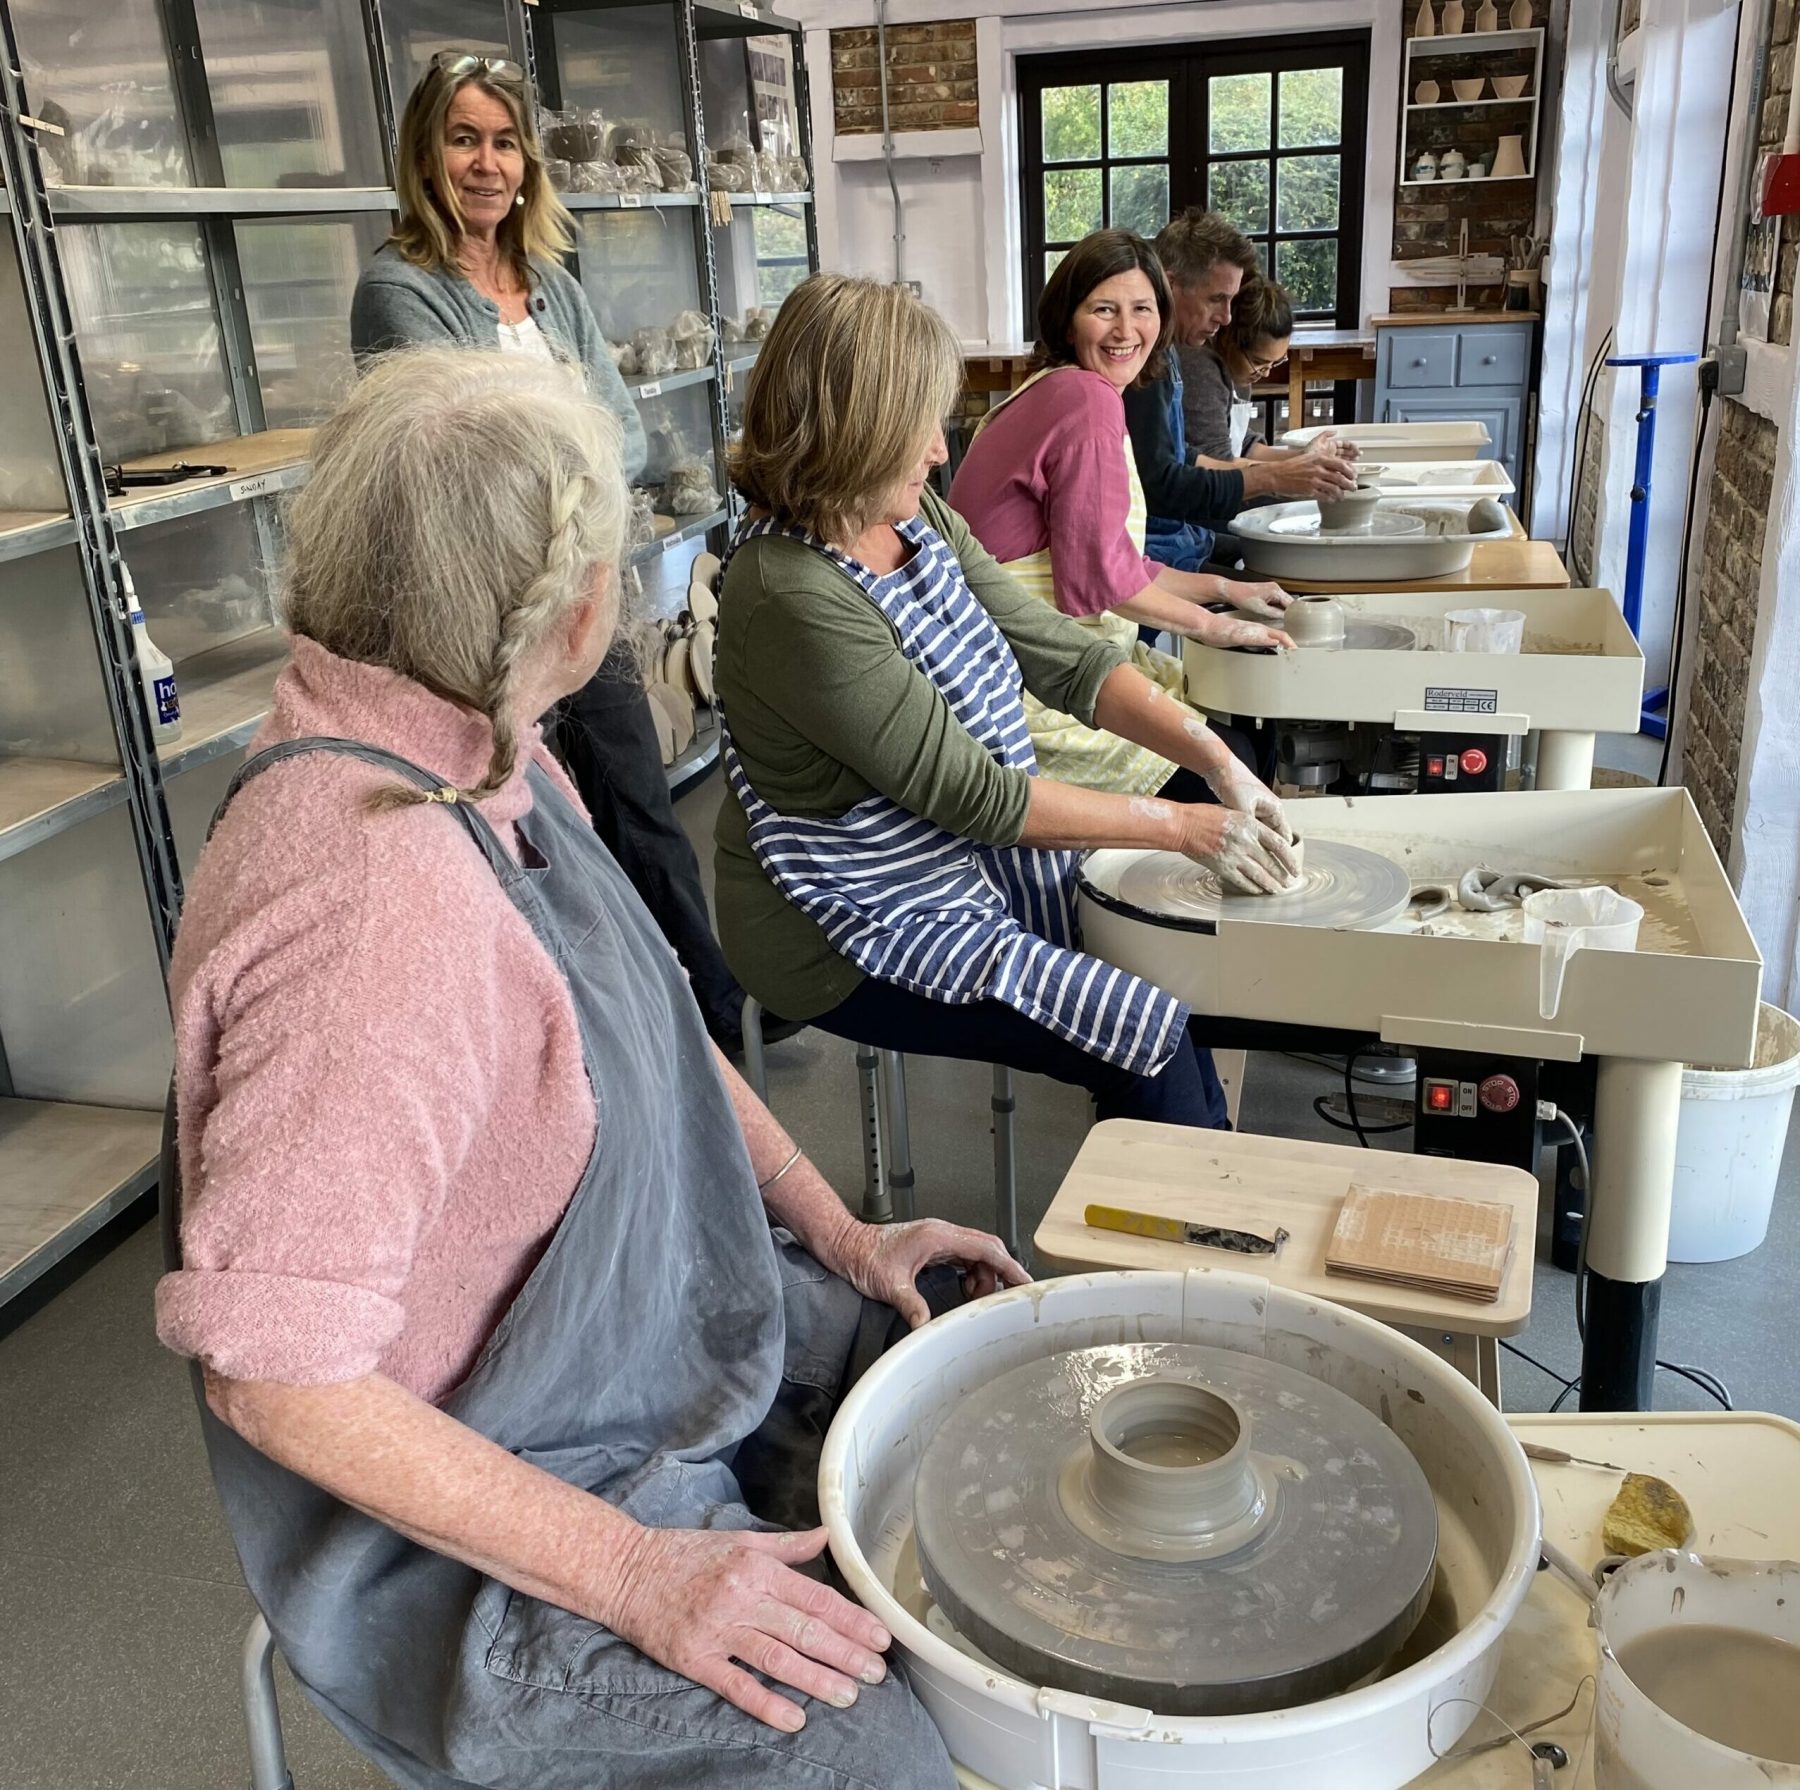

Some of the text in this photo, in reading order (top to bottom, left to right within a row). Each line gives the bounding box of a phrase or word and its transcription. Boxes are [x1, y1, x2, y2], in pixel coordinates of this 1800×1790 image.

[1428, 689, 1468, 699] Roderveld
[1481, 701, 1494, 711] CE
[1482, 1080, 1504, 1092] STOP
[1506, 1086, 1516, 1108] STOP
[1461, 1104, 1473, 1112] OFF
